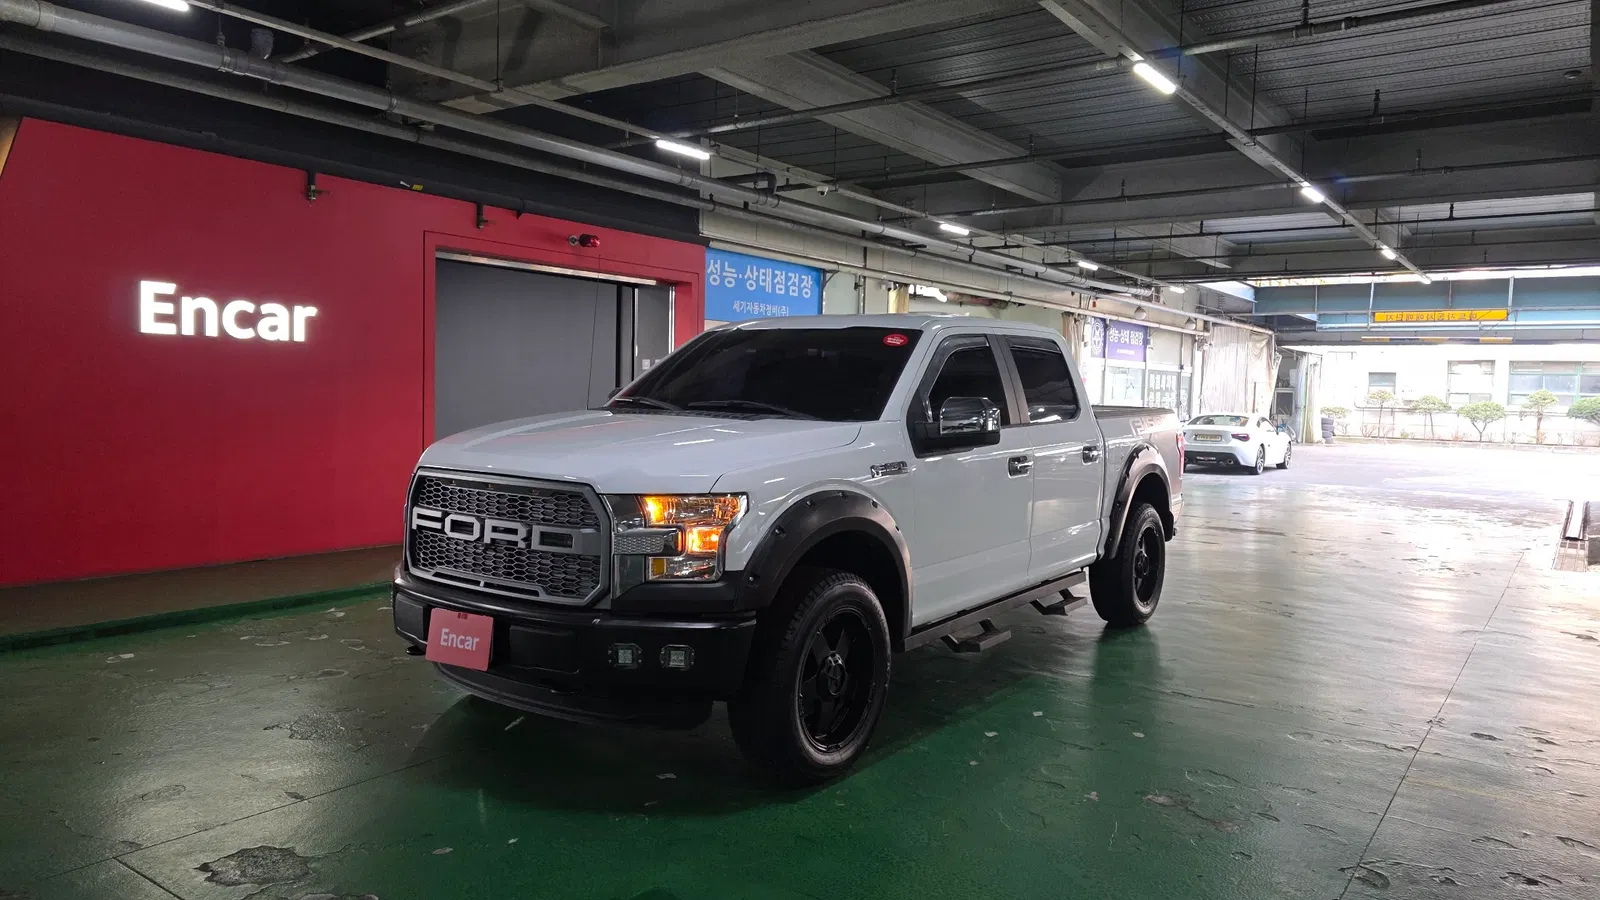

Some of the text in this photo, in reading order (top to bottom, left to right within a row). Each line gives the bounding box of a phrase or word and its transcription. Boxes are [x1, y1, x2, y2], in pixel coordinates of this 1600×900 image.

[707, 259, 812, 298] 성능·상태점검장
[140, 280, 318, 342] Encar
[733, 300, 789, 317] 세기자동차정비(주)
[412, 506, 575, 551] FORD
[440, 628, 480, 651] Encar
